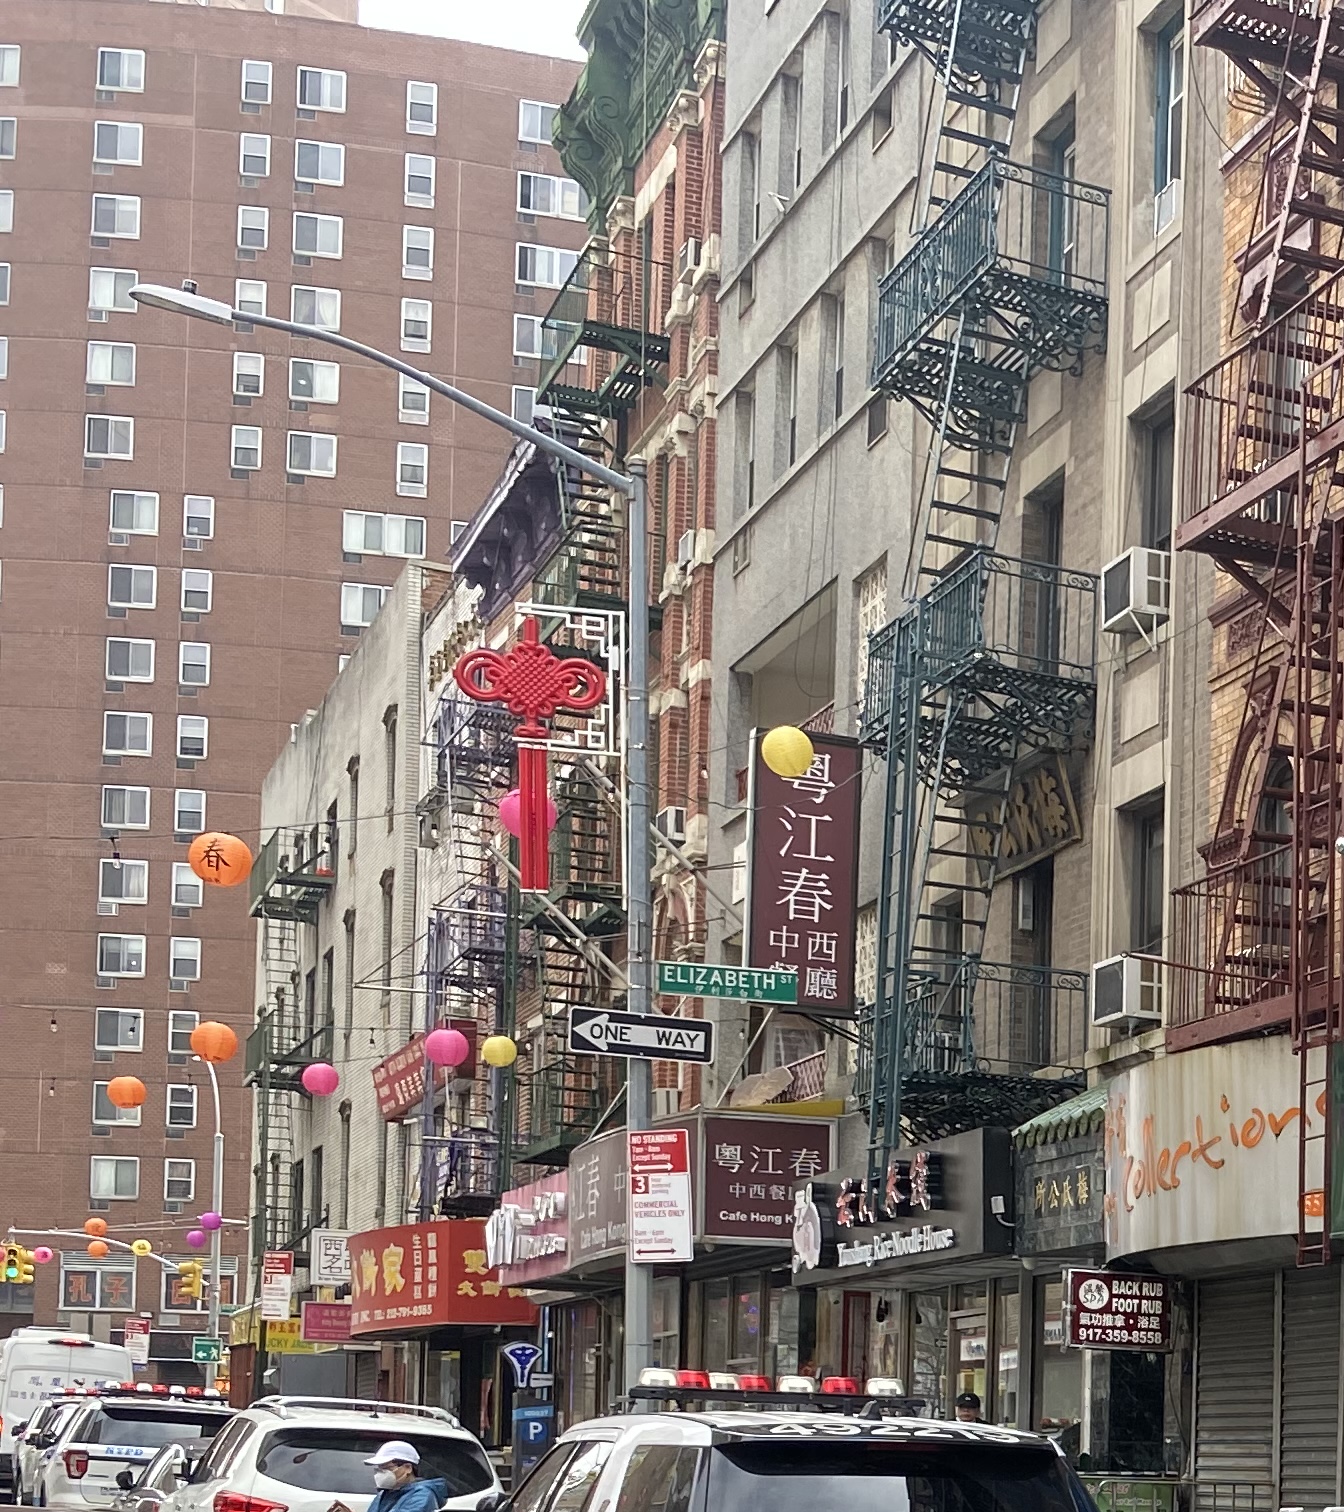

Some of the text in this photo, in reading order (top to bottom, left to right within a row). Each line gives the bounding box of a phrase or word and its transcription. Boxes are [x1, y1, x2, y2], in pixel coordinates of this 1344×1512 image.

[664, 966, 793, 990] ELIZABETH ST
[590, 1023, 700, 1049] ONE WAY
[631, 1134, 678, 1144] NO STANDING
[651, 1153, 671, 1161] Sunday
[635, 1176, 646, 1193] 3
[634, 1200, 678, 1209] COMMERCIAL
[635, 1210, 666, 1218] VEHICLES
[720, 1211, 748, 1222] Cafe
[750, 1213, 782, 1225] Hong
[1112, 1281, 1163, 1297] BACK RUB
[1082, 1293, 1105, 1304] SPA
[1112, 1298, 1163, 1314] FOOT RUB
[1079, 1328, 1162, 1344] 917-359-8558
[529, 1421, 543, 1440] P
[105, 1446, 144, 1456] NYPD
